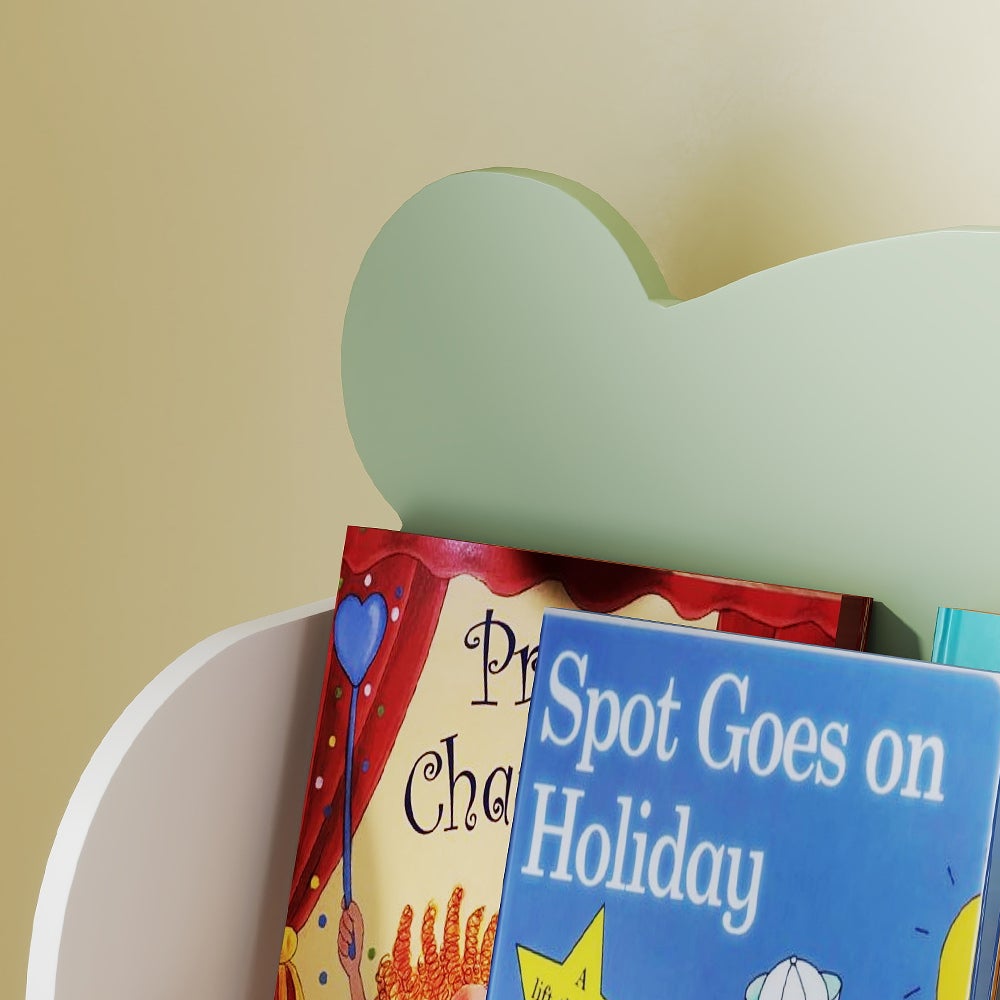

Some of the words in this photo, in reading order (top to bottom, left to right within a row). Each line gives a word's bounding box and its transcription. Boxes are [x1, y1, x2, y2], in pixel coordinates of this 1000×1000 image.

[539, 649, 679, 773] Spot
[698, 672, 850, 788] Goes
[866, 726, 945, 802] on
[521, 782, 765, 935] Holiday
[575, 967, 587, 991] A
